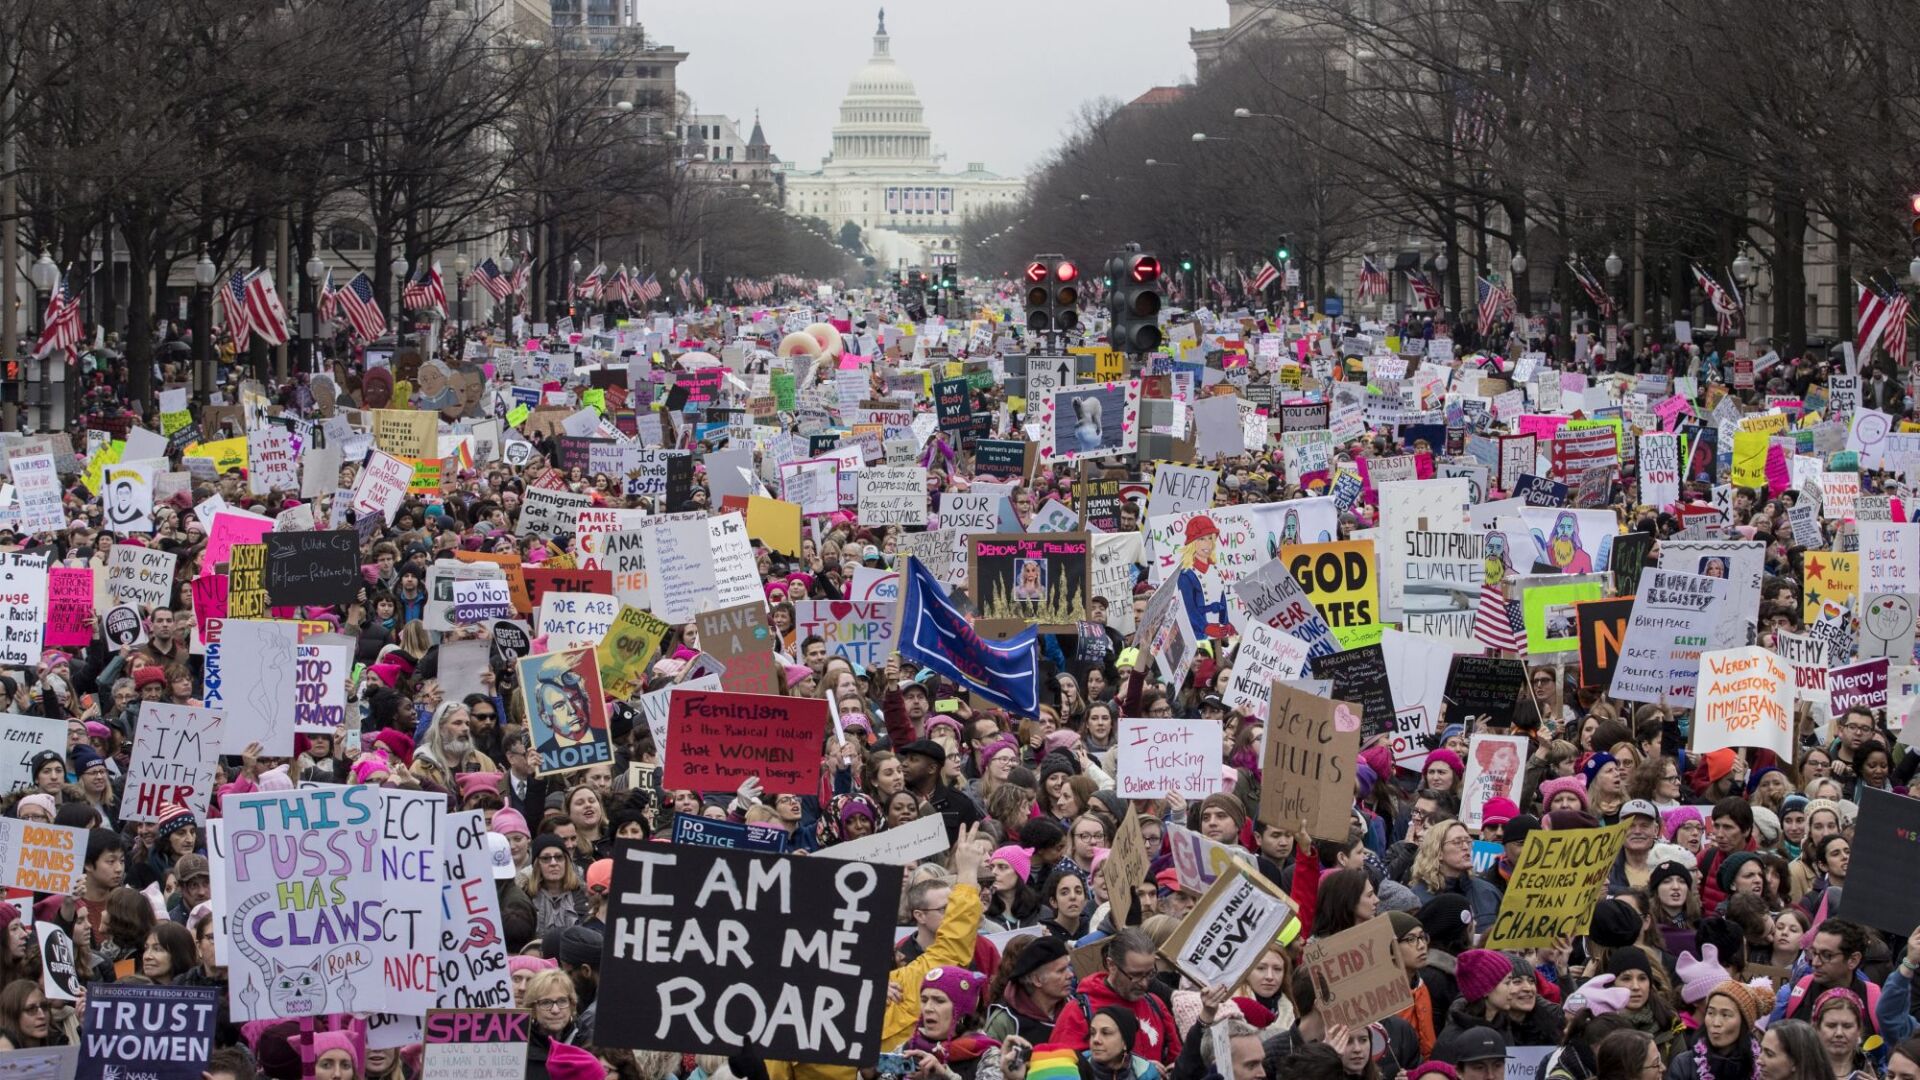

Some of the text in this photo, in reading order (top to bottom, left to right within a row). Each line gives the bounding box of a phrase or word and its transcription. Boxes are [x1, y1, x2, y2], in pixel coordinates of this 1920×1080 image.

[1029, 360, 1052, 370] THRU
[1104, 354, 1120, 366] MY
[944, 384, 958, 394] MY
[1832, 376, 1857, 388] Real
[941, 394, 964, 406] Body
[1831, 392, 1856, 400] Men
[940, 414, 970, 425] Choice
[946, 406, 961, 416] MY
[1283, 408, 1302, 417] YOU
[1590, 428, 1610, 436] MARCH
[1742, 416, 1786, 432] HISTORY
[1646, 434, 1674, 448] PAID
[260, 451, 287, 462] WITH
[888, 454, 916, 463] FUTURE
[1367, 456, 1414, 470] DIVERSITY
[1641, 448, 1676, 460] FAMILY
[266, 462, 288, 474] HER
[382, 458, 400, 476] NO
[859, 468, 916, 480] where there is
[976, 464, 1024, 473] REVOLUTION
[1644, 459, 1676, 471] LEAVE
[369, 466, 406, 492] GRABBING
[1158, 470, 1210, 501] NEVER
[1531, 478, 1554, 491] OUR
[1648, 471, 1674, 484] NOW
[366, 489, 388, 507] TIME
[372, 482, 392, 498] ANY
[526, 489, 592, 508] Immigrants
[1520, 488, 1560, 508] RIGHTS
[1824, 484, 1858, 495] UNIDO
[860, 496, 914, 510] there will be
[952, 496, 989, 512] OUR
[1088, 499, 1112, 509] HUMAN
[525, 506, 576, 526] Get The
[578, 512, 616, 522] MAKE
[867, 510, 922, 524] RESISTANCE
[940, 514, 995, 530] PUSSIES
[526, 521, 576, 538] Job Don
[1218, 532, 1245, 550] WHO
[117, 549, 171, 568] YOU CAN'T
[231, 545, 268, 570] DISSENT
[1830, 557, 1851, 572] We
[6, 572, 14, 580] a
[140, 568, 168, 587] OVER
[234, 571, 260, 590] IS THE
[1290, 552, 1368, 595] GOD
[1406, 562, 1484, 583] CLIMATE
[53, 588, 90, 596] WOMEN
[108, 581, 164, 604] MISOGYNY
[474, 582, 491, 590] WE
[1654, 573, 1714, 593] HUMAN
[1827, 578, 1854, 591] Better
[230, 592, 265, 617] HIGHEST
[456, 590, 508, 604] DO NOT
[1646, 588, 1716, 611] REGISTRY
[10, 606, 38, 622] Racist
[553, 600, 614, 616] WE ARE
[1268, 601, 1311, 630] FEAR
[620, 608, 669, 638] RESPECT
[703, 607, 760, 636] HAVE
[6, 625, 38, 644] Rapist
[800, 622, 893, 642] TRUMPS
[1674, 636, 1706, 647] EARTH
[1814, 620, 1854, 650] RESPECT
[616, 634, 645, 656] OUR
[730, 634, 743, 654] A
[1242, 644, 1296, 678] are not up
[1708, 655, 1787, 682] WEREN'T YOUR
[1708, 676, 1776, 696] ANCESTORS
[1829, 671, 1874, 692] Mercy
[1707, 696, 1788, 732] IMMIGRANTS
[1726, 714, 1761, 732] TOO?
[4, 728, 44, 745] FEMME
[152, 726, 202, 763] I'M
[1130, 726, 1194, 746] I can't
[540, 742, 609, 770] NOPE
[680, 742, 794, 764] that WOMEN
[1144, 746, 1204, 777] fucking
[141, 760, 197, 784] WITH
[1124, 774, 1218, 794] Believe this SHIT
[136, 782, 194, 817] HER
[240, 785, 371, 831] THIS
[456, 814, 484, 850] of
[682, 820, 704, 832] DO
[22, 825, 74, 850] BODIES
[679, 830, 736, 848] JUSTICE
[19, 848, 75, 874] MINDS
[232, 828, 378, 882] PUSSY
[16, 868, 70, 893] POWER
[620, 848, 792, 914] I AM
[276, 876, 348, 912] HAS
[252, 900, 383, 948] CLAWS
[1188, 880, 1254, 966] RESISTANCE
[1224, 922, 1234, 932] IS
[613, 917, 862, 976] HEAR ME
[1208, 902, 1265, 972] LOVE
[1305, 944, 1328, 963] not
[328, 950, 369, 977] ROAR
[438, 950, 506, 988] to lose
[1310, 938, 1376, 990] READY
[94, 988, 148, 997] REPRODUCTIVE
[150, 990, 182, 998] FREEDOM
[91, 1001, 213, 1032] TRUST
[654, 976, 874, 1060] ROAR!
[426, 1012, 530, 1044] SPEAK
[87, 1034, 210, 1062] WOMEN
[442, 1056, 472, 1066] HUMAN
[488, 1056, 520, 1066] ILLEGAL
[126, 1072, 158, 1080] NARAL
